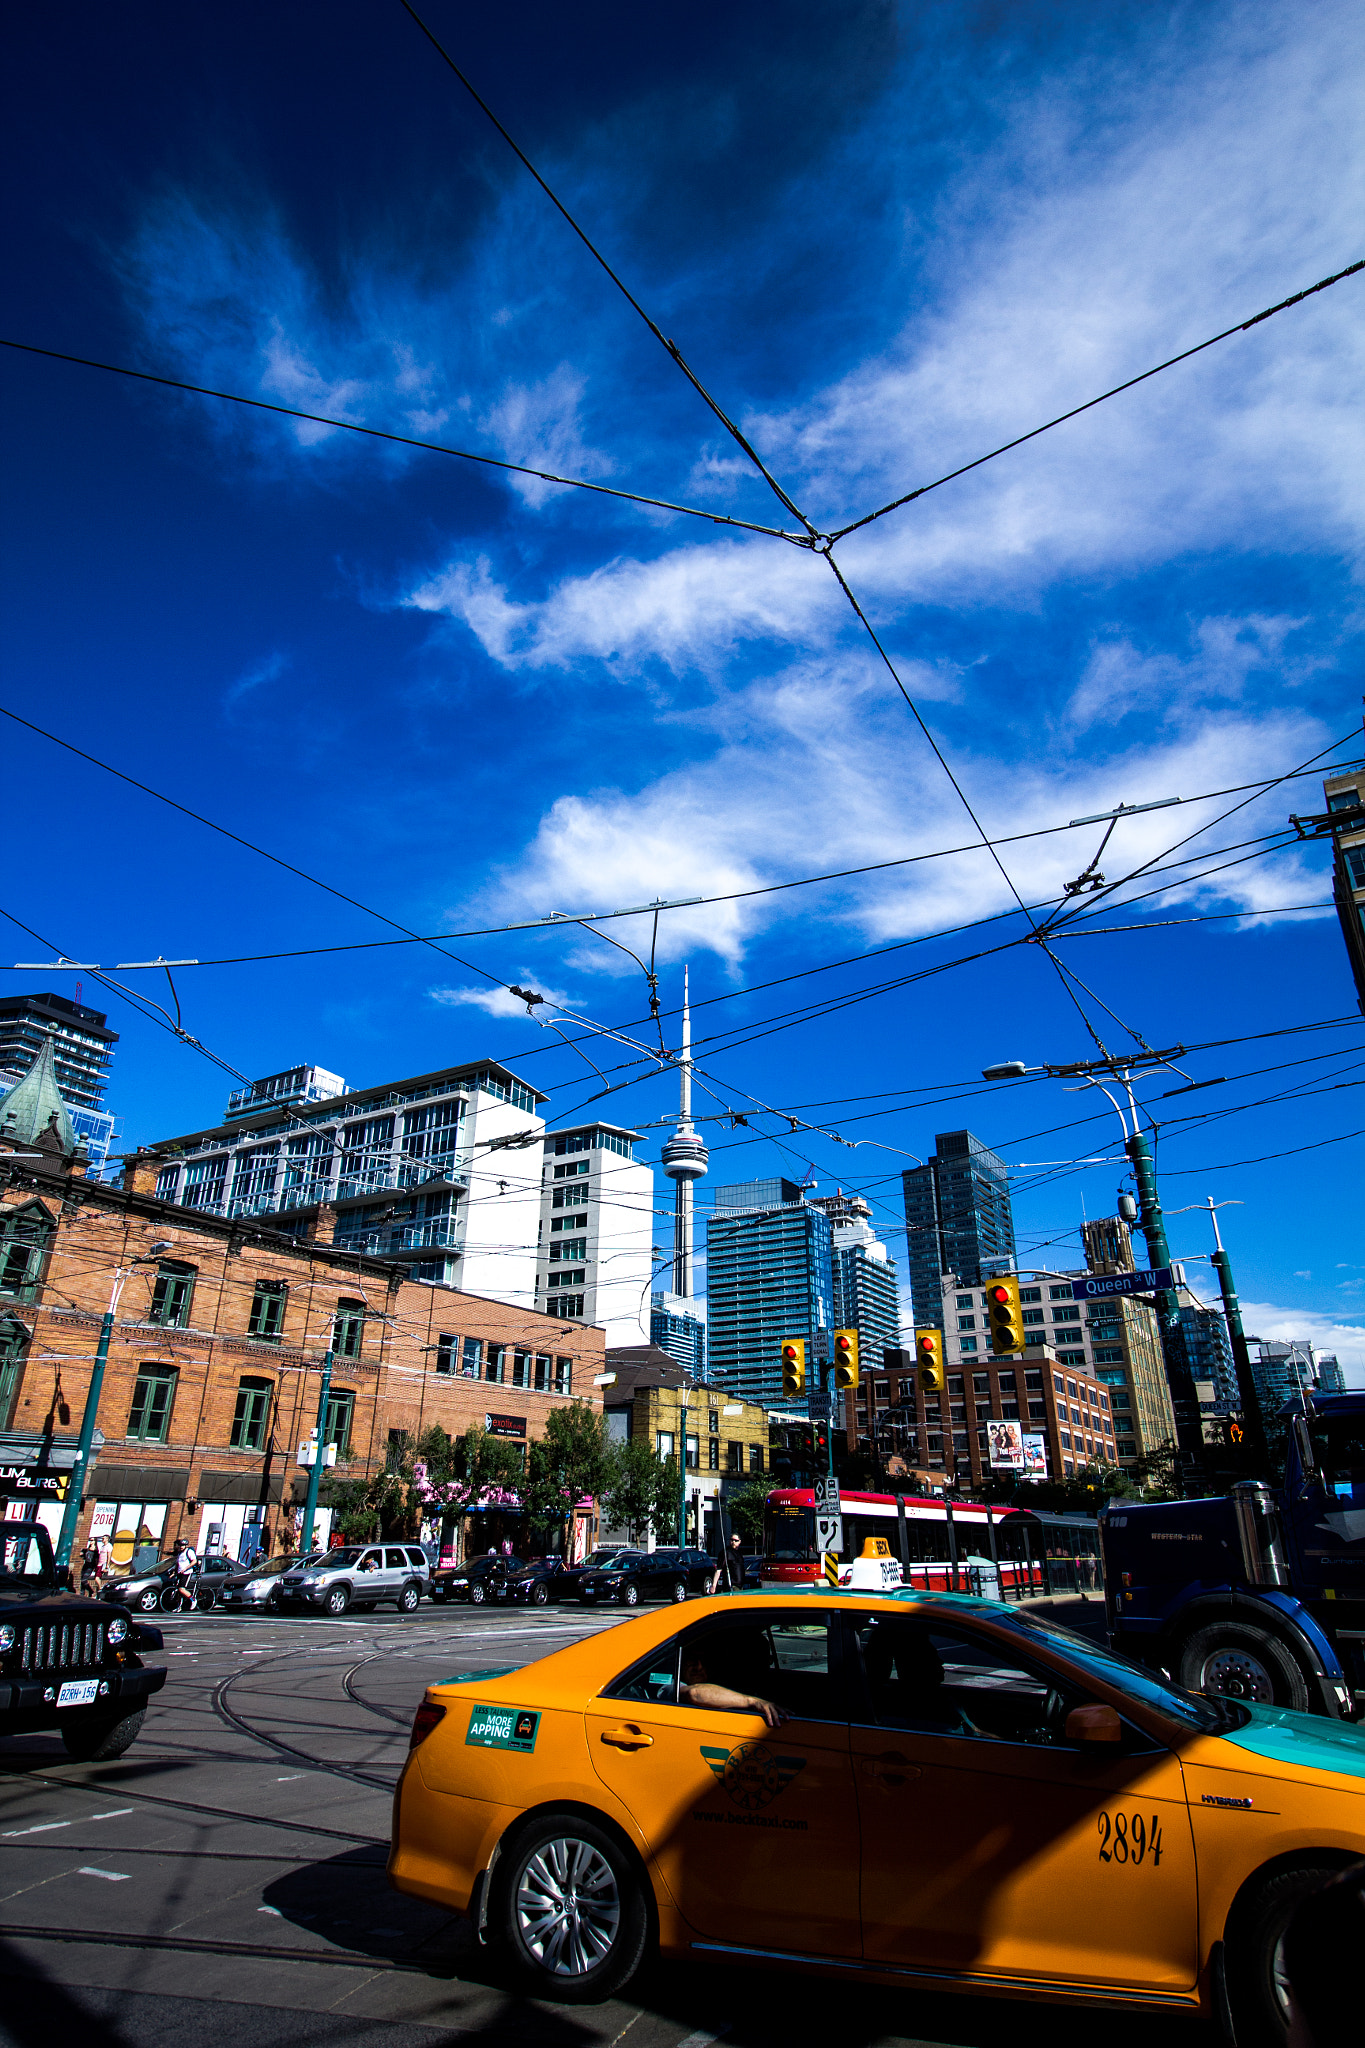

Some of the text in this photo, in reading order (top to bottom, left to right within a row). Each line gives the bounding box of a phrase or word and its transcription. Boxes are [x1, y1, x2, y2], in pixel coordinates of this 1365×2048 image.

[1086, 1272, 1156, 1294] Queen St W
[810, 1395, 829, 1406] TRANSIT
[811, 1406, 829, 1417] SIGNAL
[93, 1514, 115, 1525] 2016
[475, 1706, 515, 1717] LESS TALKING
[486, 1714, 514, 1727] MORE
[470, 1722, 511, 1739] APPING
[728, 1745, 775, 1774] BECK
[729, 1781, 774, 1809] TAXI
[692, 1811, 808, 1830] www.becktaxi.com
[1098, 1811, 1164, 1866] 2894
